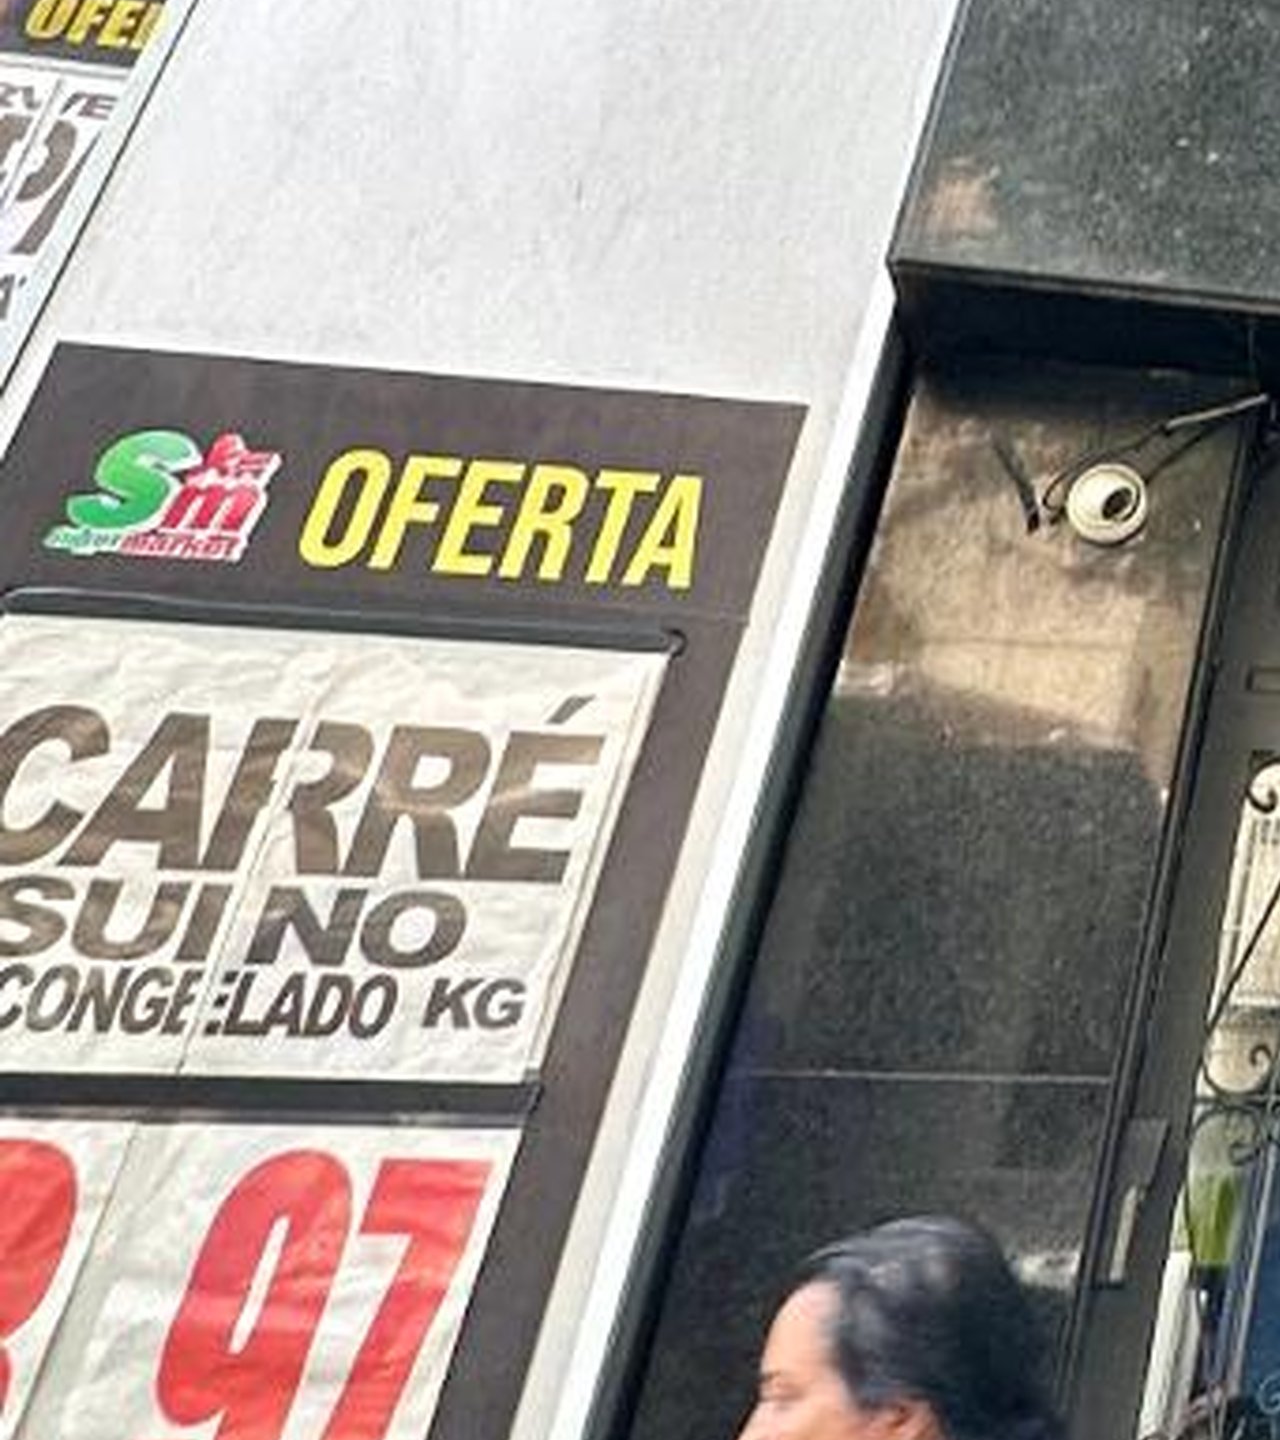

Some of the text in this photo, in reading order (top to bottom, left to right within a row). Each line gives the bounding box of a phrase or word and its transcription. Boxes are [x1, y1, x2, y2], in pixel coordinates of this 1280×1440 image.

[298, 448, 704, 590] OFERTA
[0, 694, 606, 884] CARRÉ
[0, 874, 468, 970] SUINO
[420, 977, 528, 1031] KG
